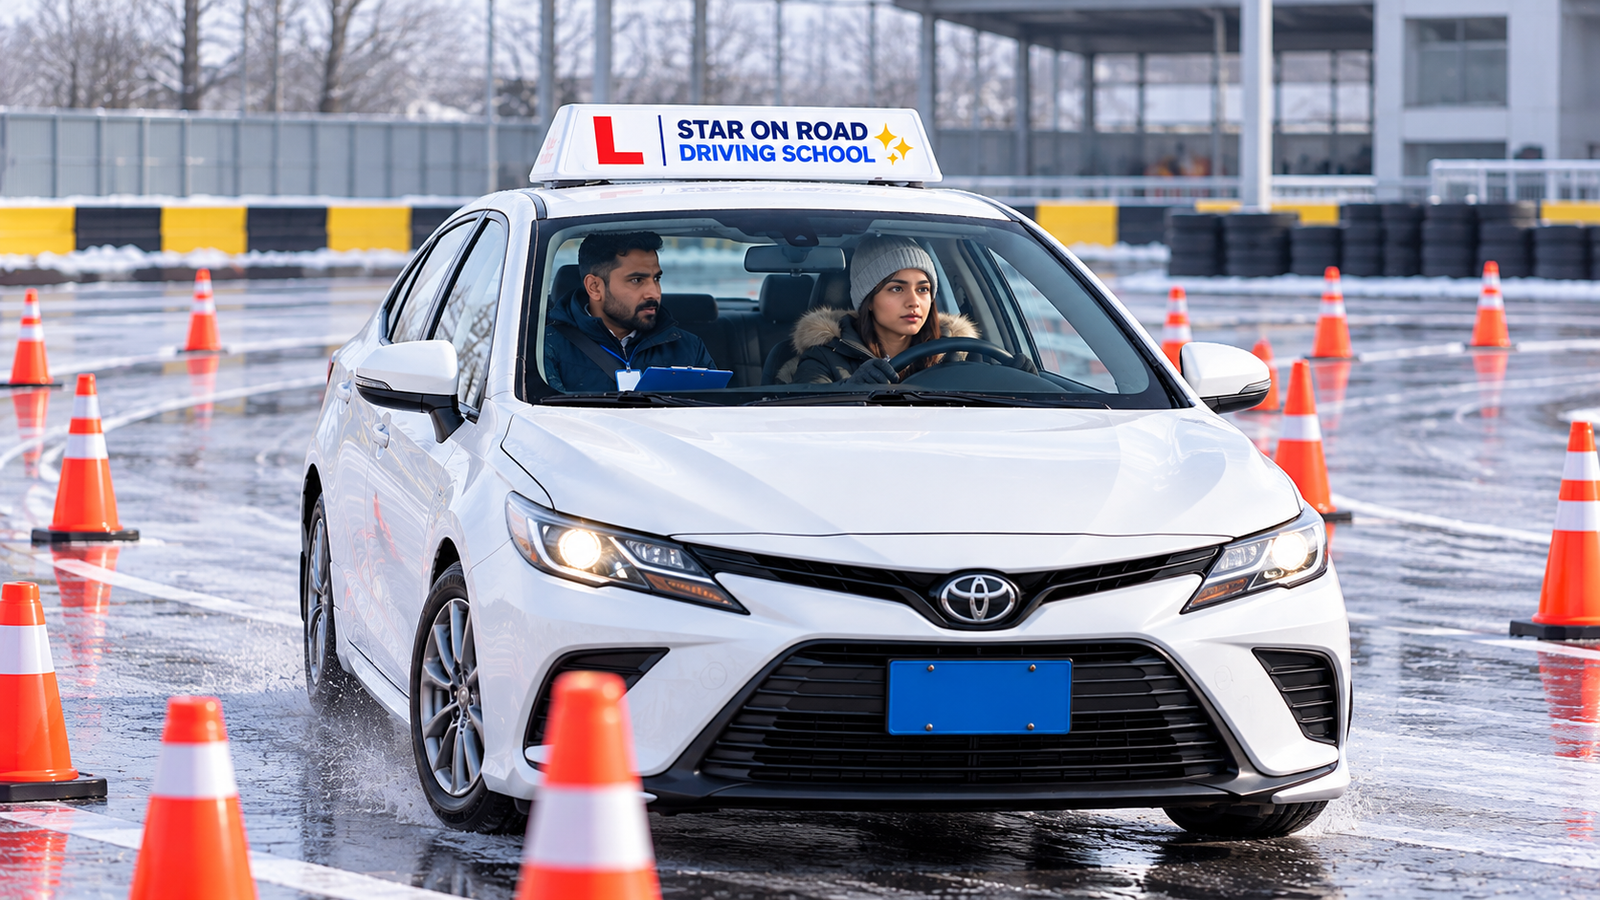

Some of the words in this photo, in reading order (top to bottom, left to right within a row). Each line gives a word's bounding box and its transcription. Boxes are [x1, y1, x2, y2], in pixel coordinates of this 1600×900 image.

[592, 115, 645, 165] L
[677, 119, 745, 140] STAR
[750, 120, 790, 140] ON
[795, 121, 869, 141] ROAD
[679, 143, 777, 162] DRIVING
[781, 144, 876, 164] SCHOOL
